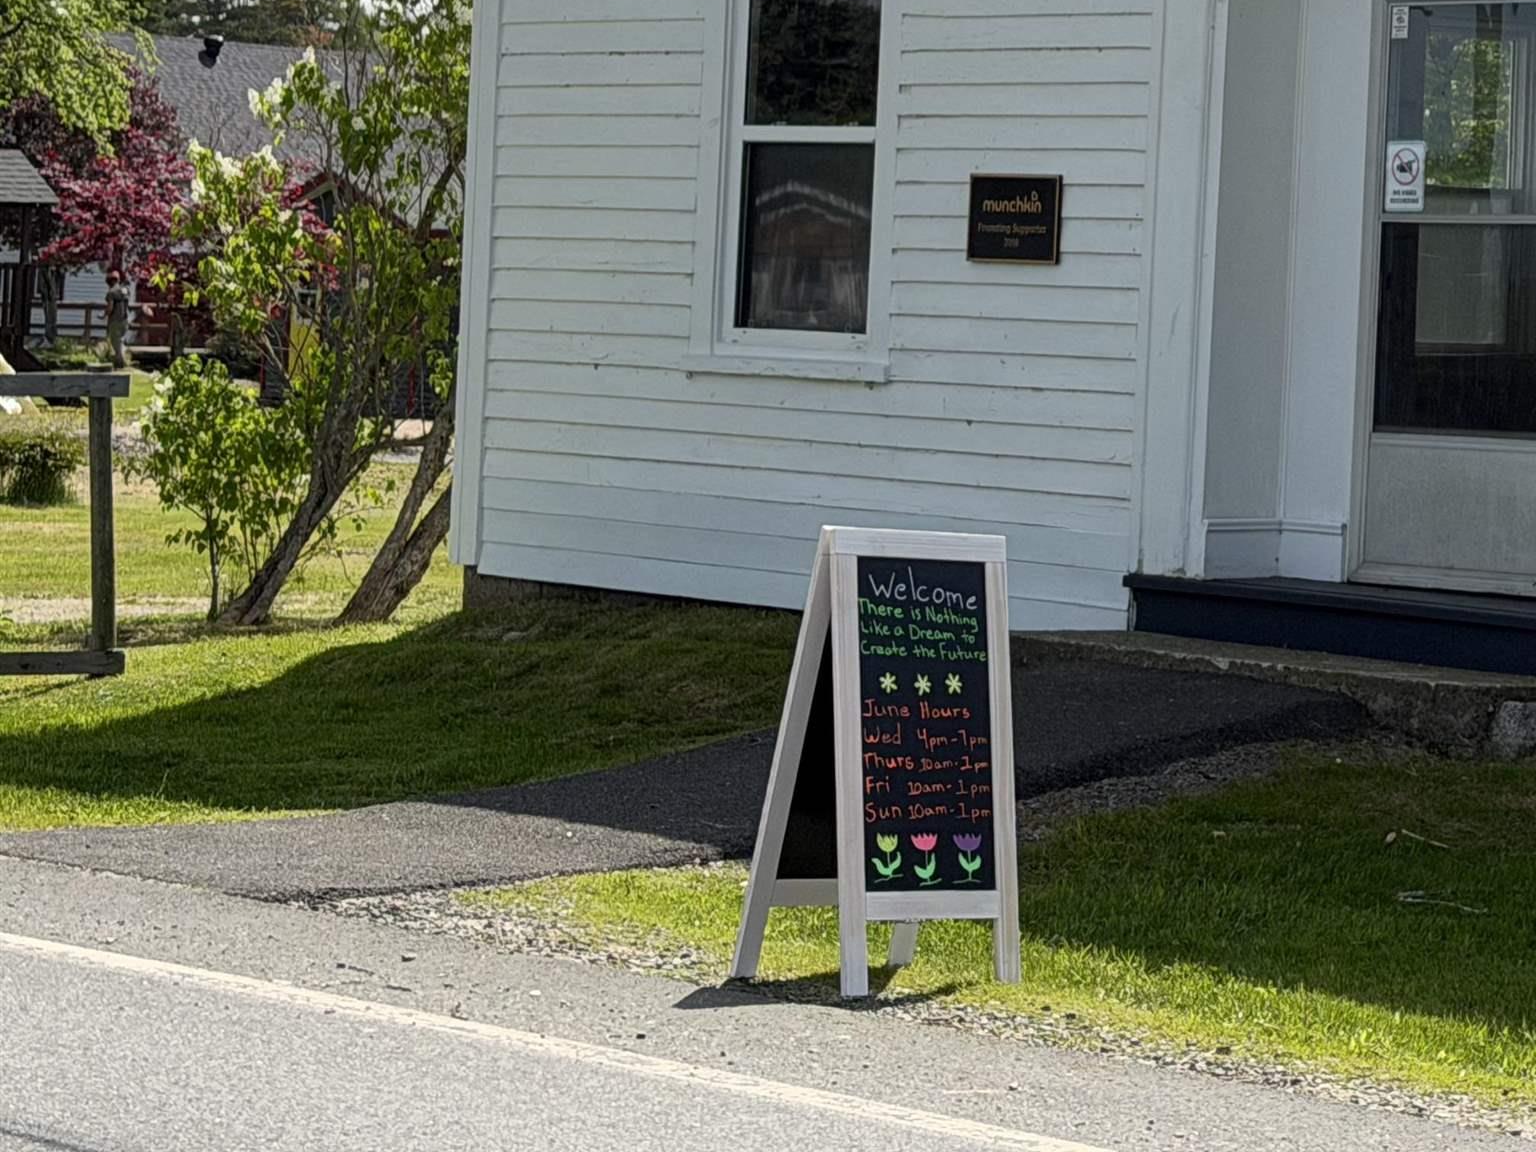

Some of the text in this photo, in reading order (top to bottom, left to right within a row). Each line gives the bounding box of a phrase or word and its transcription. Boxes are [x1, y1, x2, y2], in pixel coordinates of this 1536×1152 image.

[982, 190, 1042, 214] munchkin
[868, 565, 978, 610] Welcome
[859, 598, 979, 633] There is Nothing
[860, 619, 976, 644] Like a Dream to
[860, 640, 987, 662] Create the Future
[862, 698, 971, 720] June Hours
[864, 722, 902, 744] Wed
[863, 752, 914, 769] Thurs
[865, 775, 890, 795] Fri
[865, 802, 902, 823] Sun
